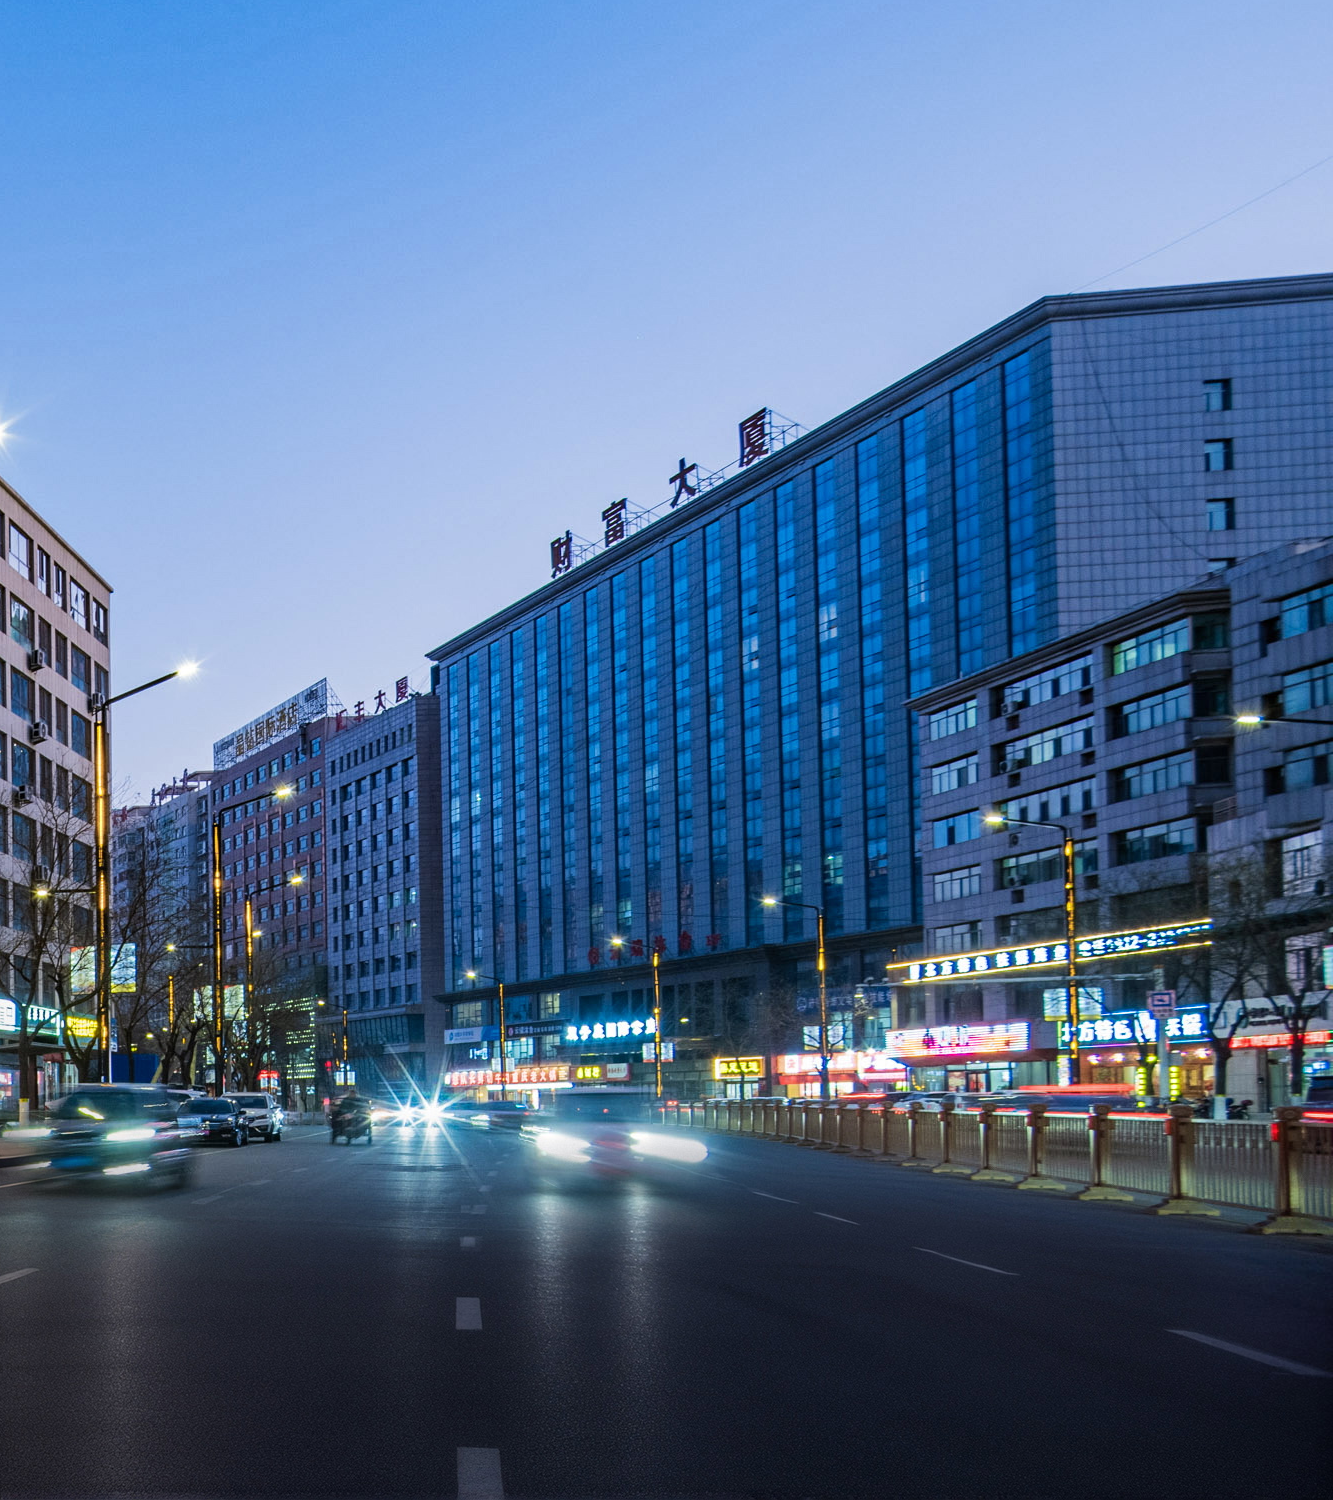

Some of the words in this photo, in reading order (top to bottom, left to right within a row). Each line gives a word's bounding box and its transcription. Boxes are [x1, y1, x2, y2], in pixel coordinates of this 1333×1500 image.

[550, 406, 770, 579] 财富大厦
[335, 675, 409, 733] 汇丰大厦
